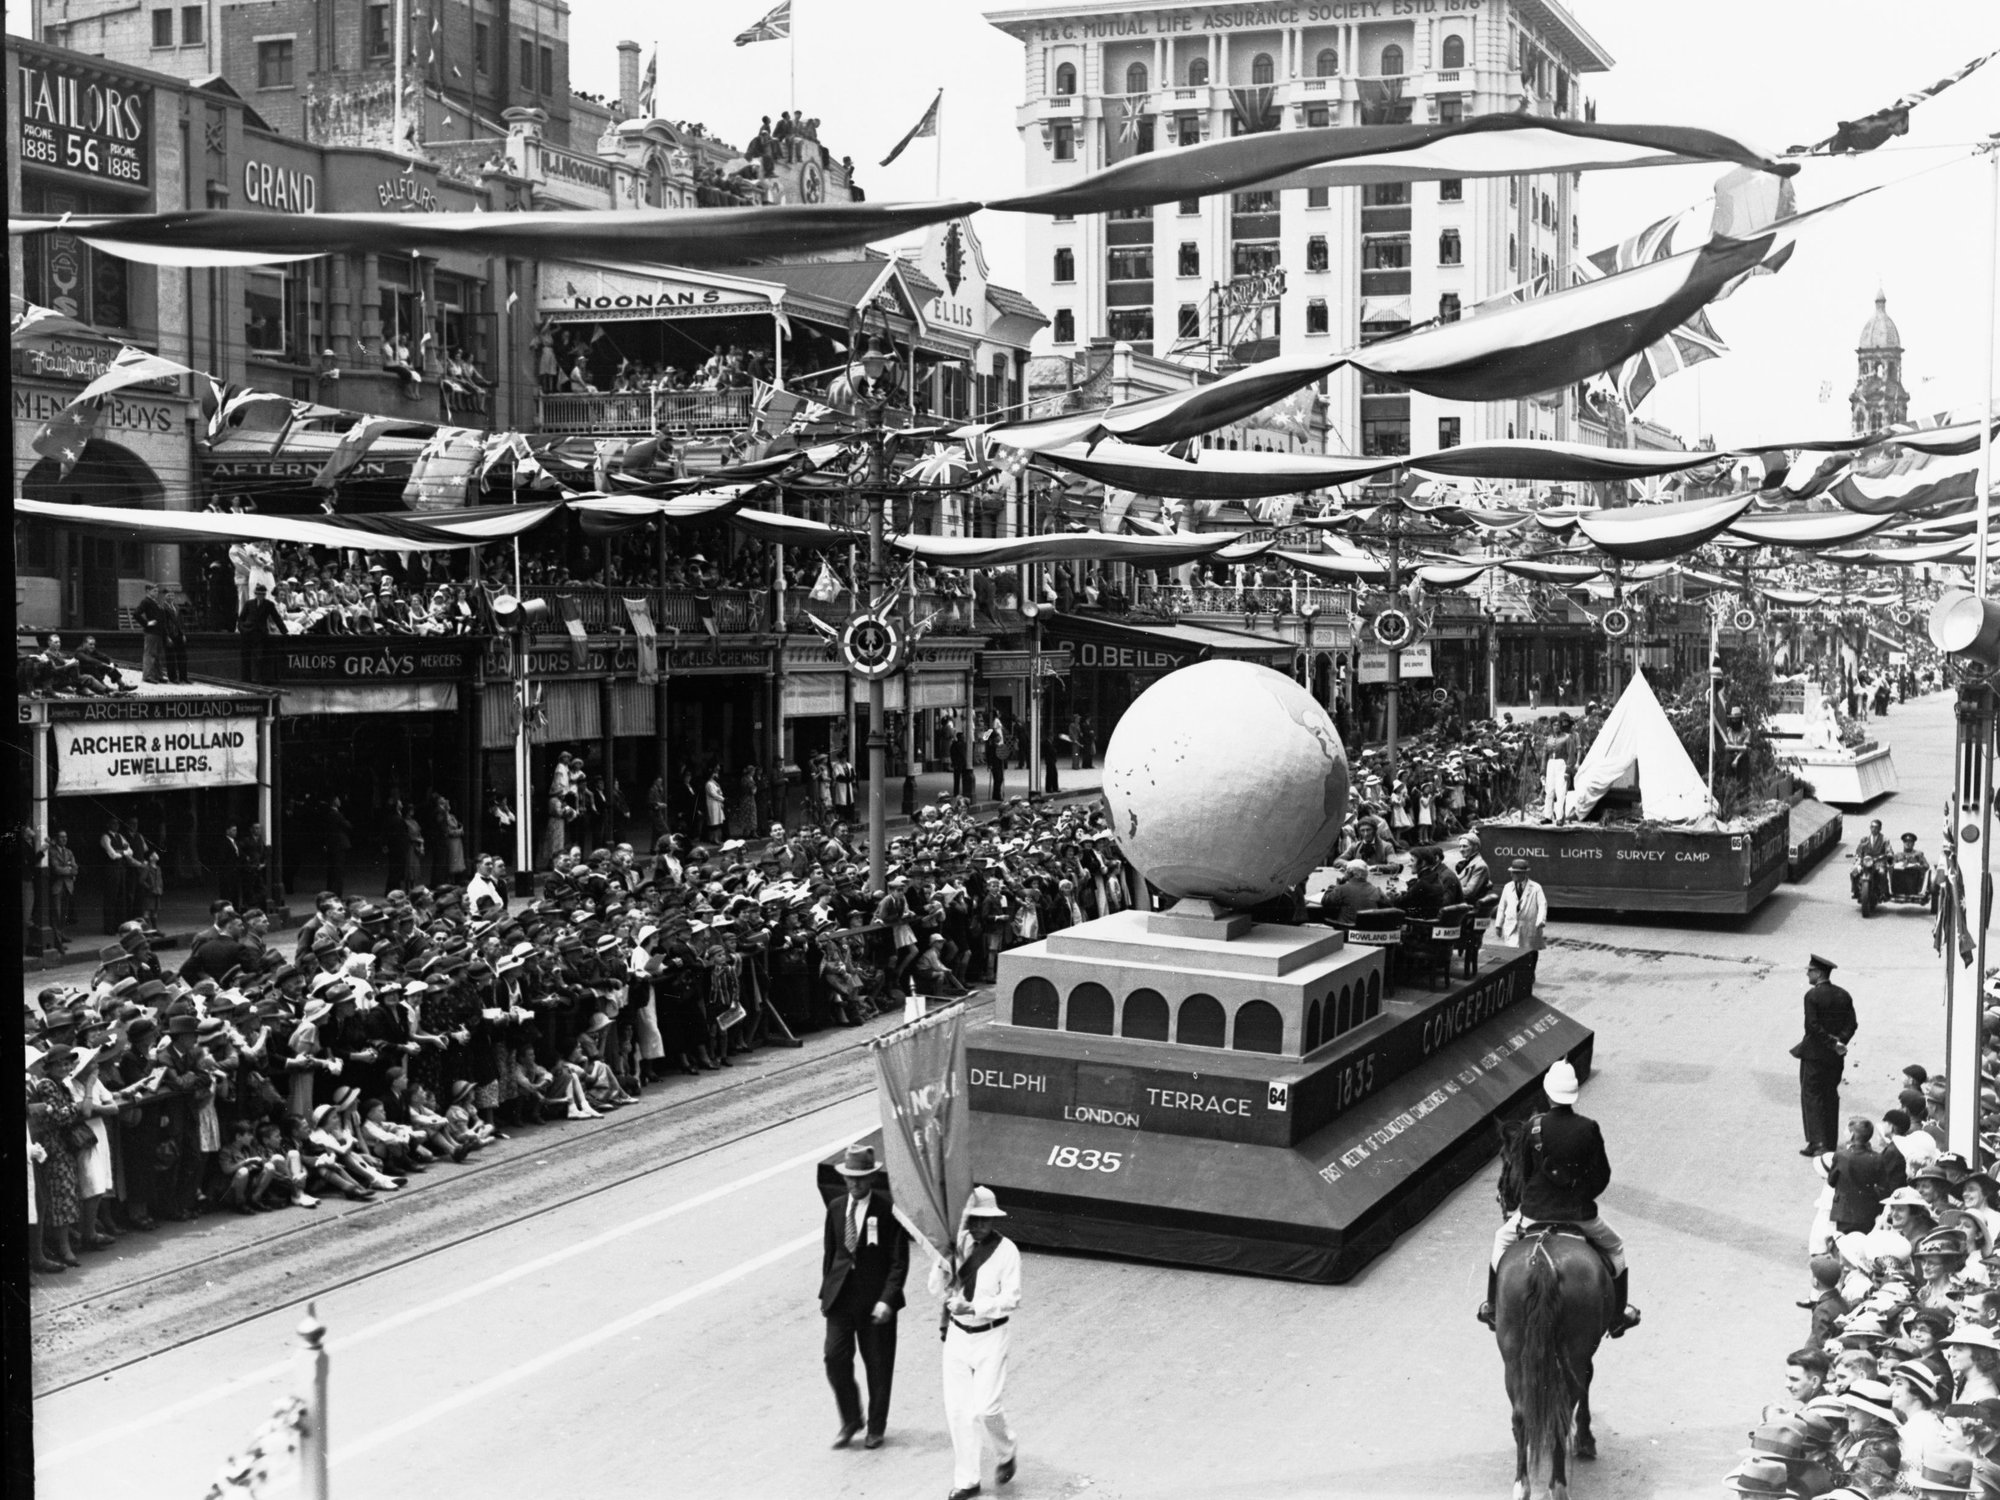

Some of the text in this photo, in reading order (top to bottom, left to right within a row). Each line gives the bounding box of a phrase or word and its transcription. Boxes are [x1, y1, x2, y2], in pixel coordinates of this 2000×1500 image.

[1084, 19, 1149, 38] MUTUAL
[1157, 16, 1192, 33] LIFE
[1203, 10, 1300, 30] ASSURANCE
[19, 66, 142, 141] TAILORS
[22, 137, 57, 163] 1885
[67, 134, 99, 172] 56
[108, 156, 141, 180] 1885
[246, 160, 315, 214] GRAND
[377, 178, 437, 214] BALFOURS
[934, 298, 973, 327] ELLIS
[111, 402, 172, 431] BOYS
[212, 462, 385, 476] AFTERNON
[288, 654, 336, 669] TAILORS
[420, 653, 462, 667] MERCERS
[487, 651, 570, 674] BAOURS
[1103, 647, 1184, 667] BEILBY
[84, 700, 233, 721] ARCHER & HOLLAND
[70, 732, 244, 756] ARCHER & HOLLAND
[107, 756, 212, 777] JEWELLERS.
[1494, 846, 1550, 858] COLONEL
[1616, 850, 1665, 862] SURVEY
[1674, 851, 1711, 862] CAMP
[1350, 932, 1388, 942] ROWLAND
[1335, 970, 1516, 1111] 1835 CONCEPTION
[970, 1068, 1046, 1093] DELPHI
[1146, 1087, 1252, 1117] TERRACE
[1268, 1086, 1287, 1107] 64
[1064, 1105, 1140, 1128] LONDON
[1046, 1144, 1123, 1173] 1835
[1318, 1162, 1345, 1184] FIRST
